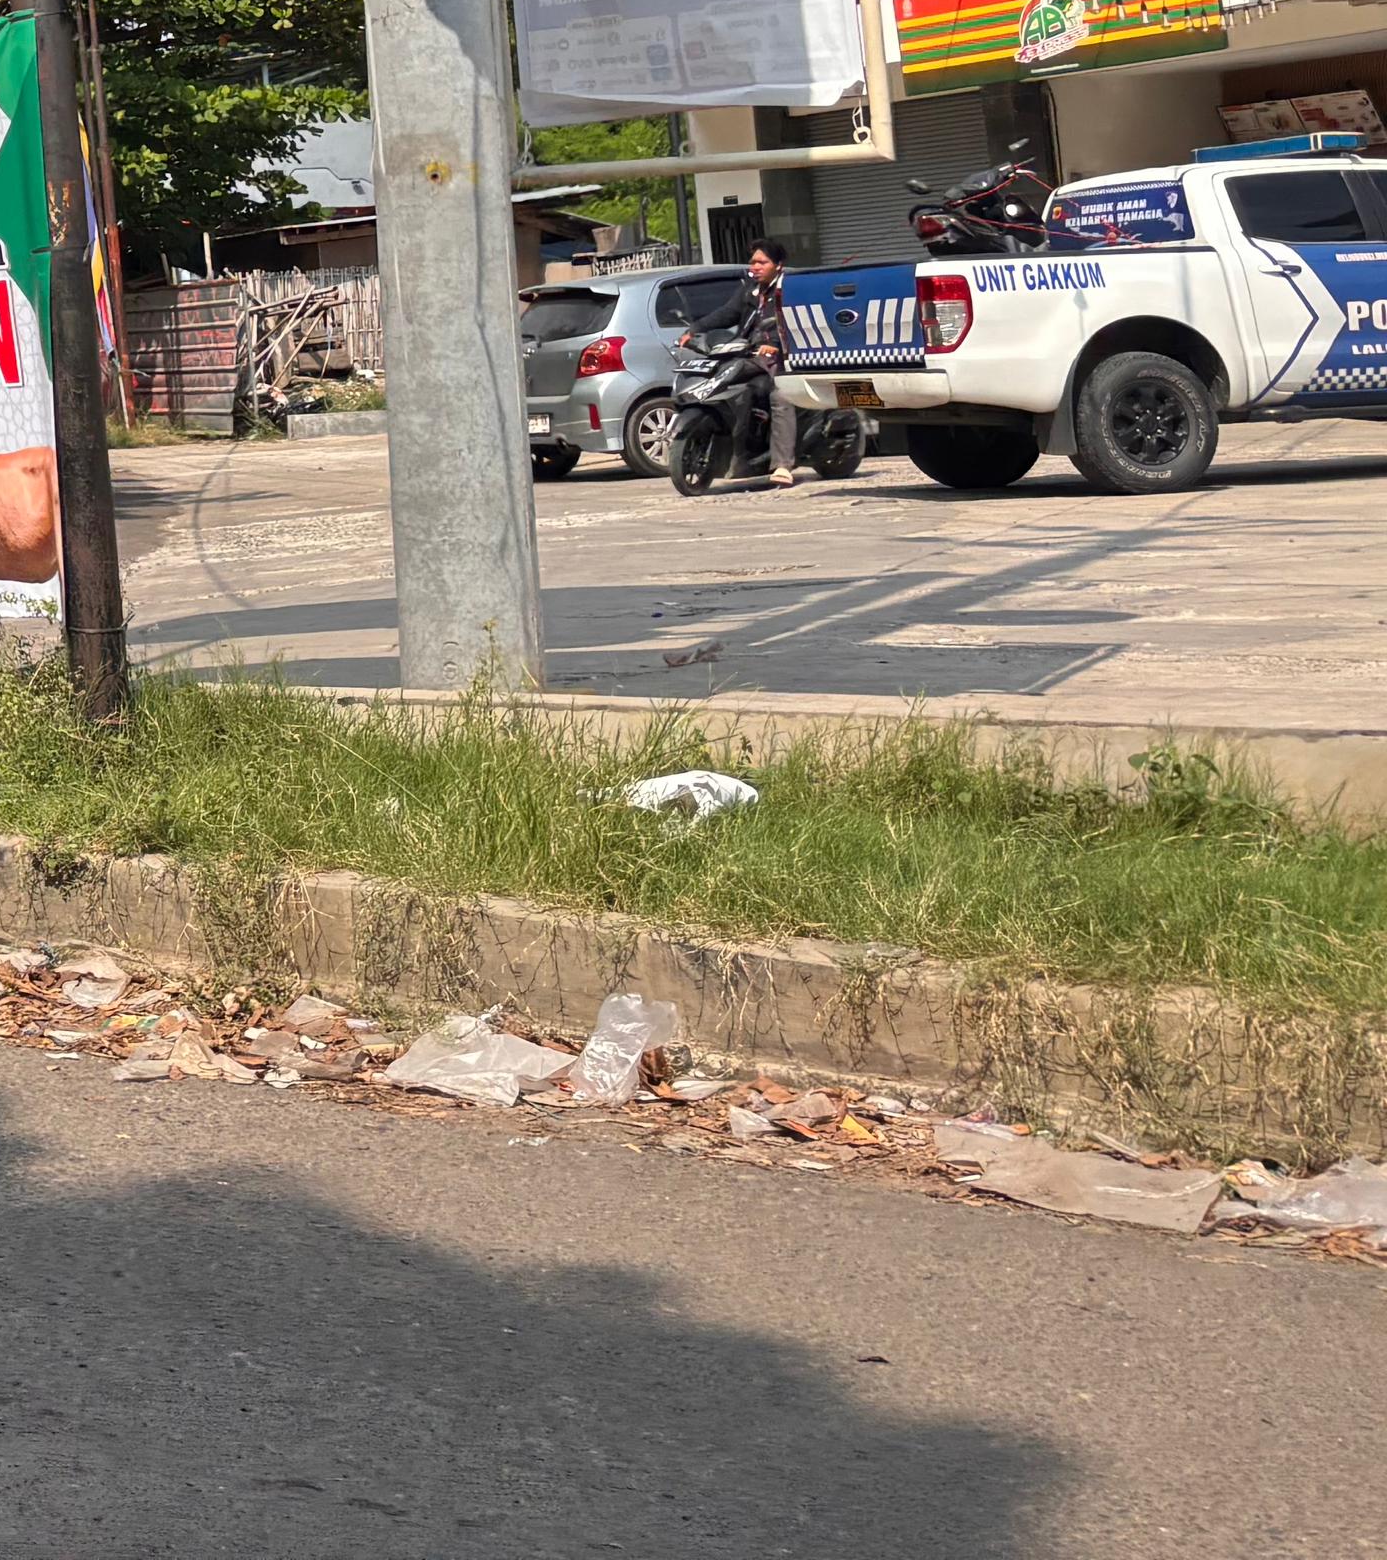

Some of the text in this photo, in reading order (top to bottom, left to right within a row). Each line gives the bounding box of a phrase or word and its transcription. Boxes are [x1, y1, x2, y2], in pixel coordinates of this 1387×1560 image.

[972, 262, 1107, 292] UNIT GAKKUM
[1346, 299, 1387, 331] PO
